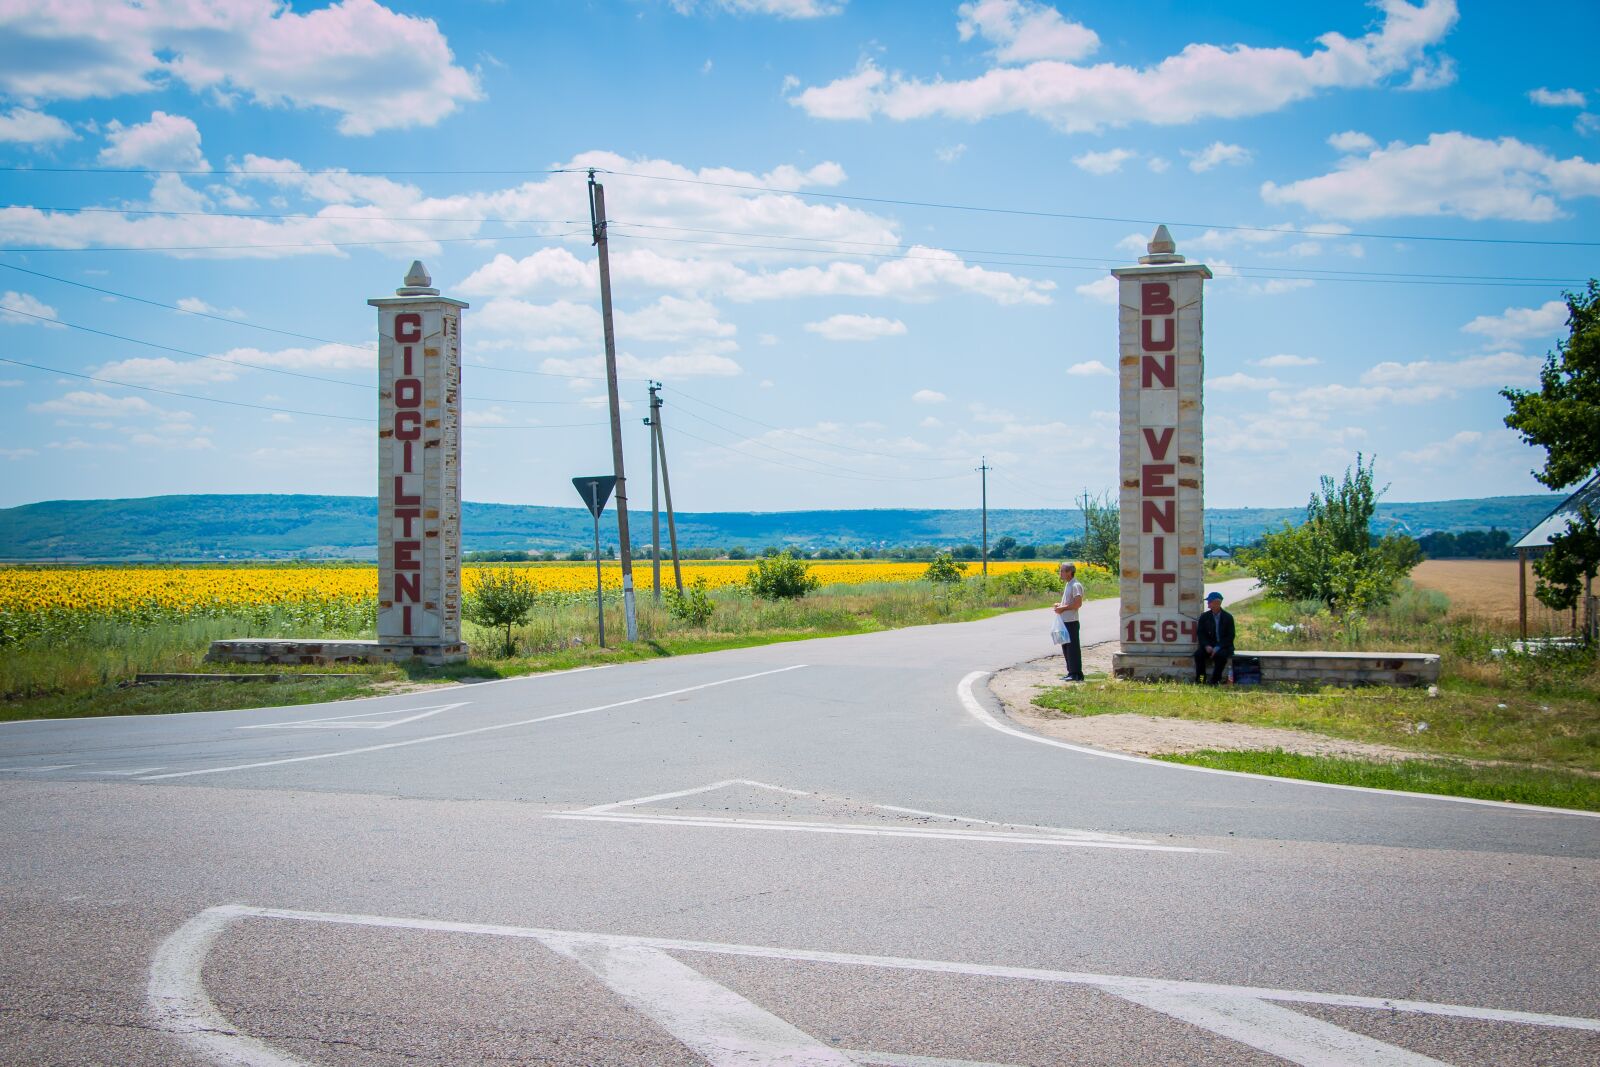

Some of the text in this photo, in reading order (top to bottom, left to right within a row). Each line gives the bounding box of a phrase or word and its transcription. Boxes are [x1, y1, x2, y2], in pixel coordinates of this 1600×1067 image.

[1141, 283, 1175, 605] BUN VENIT
[1125, 620, 1198, 643] 1564
